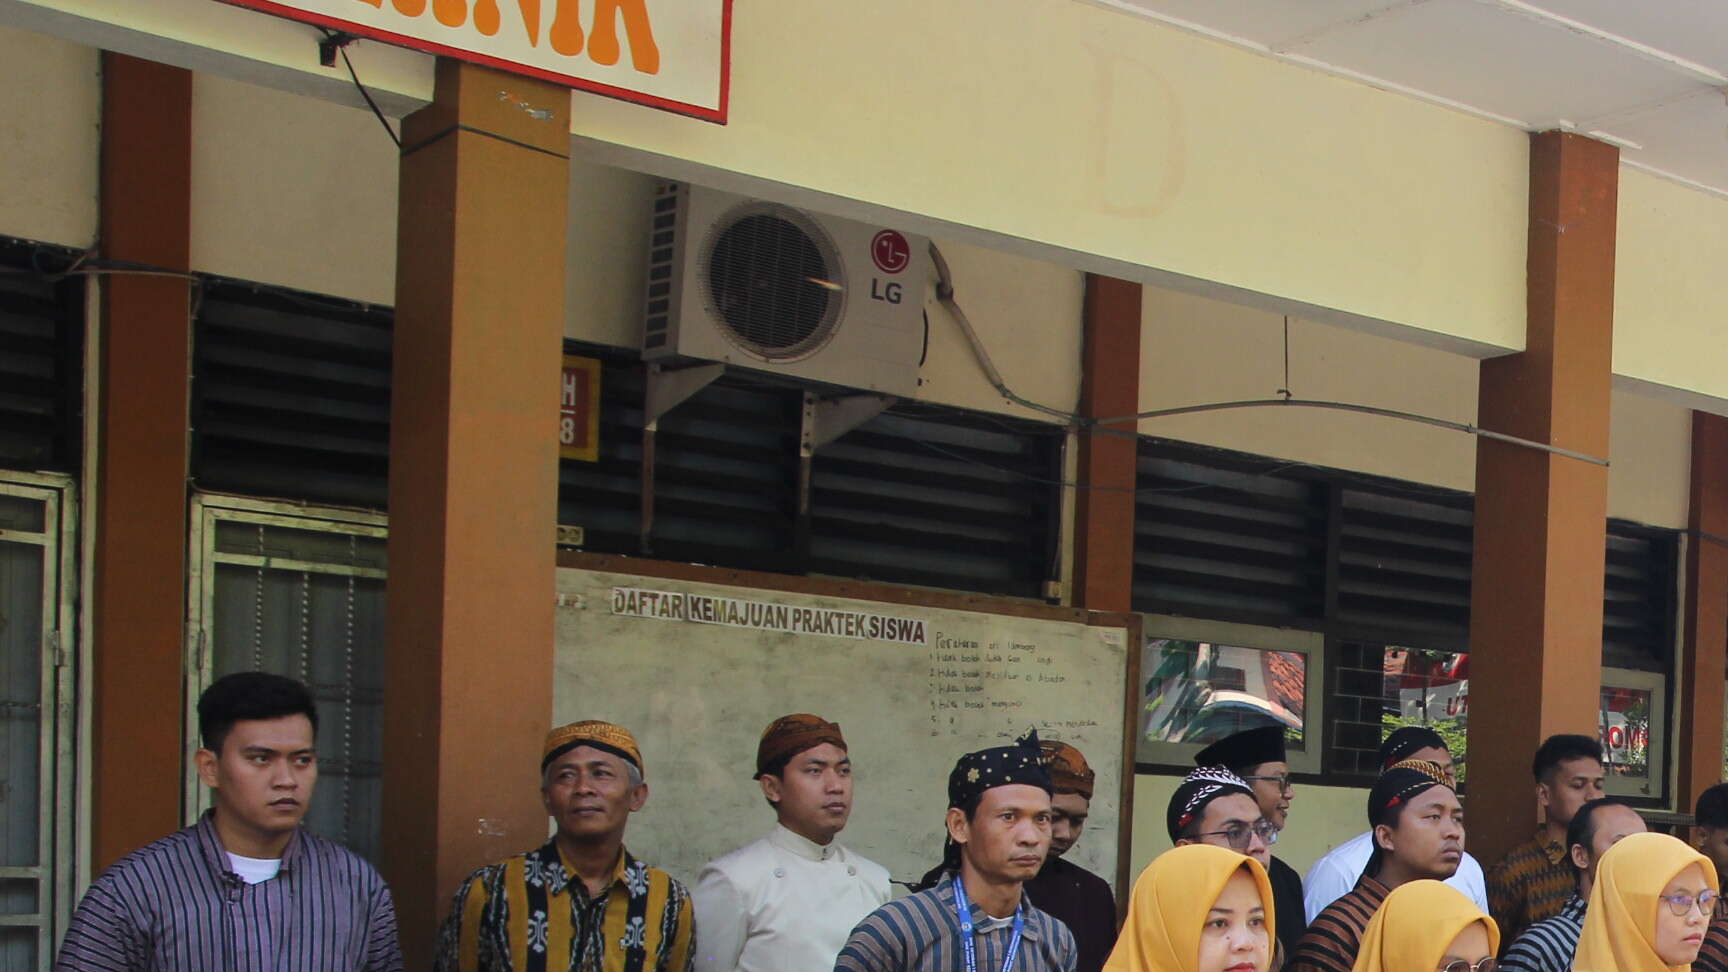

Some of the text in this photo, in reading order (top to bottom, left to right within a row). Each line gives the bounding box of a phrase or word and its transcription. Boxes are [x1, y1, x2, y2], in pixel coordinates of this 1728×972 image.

[871, 278, 902, 304] LG
[614, 588, 925, 643] DAFTAR KEMAJUAN PRAKTEK SISWA
